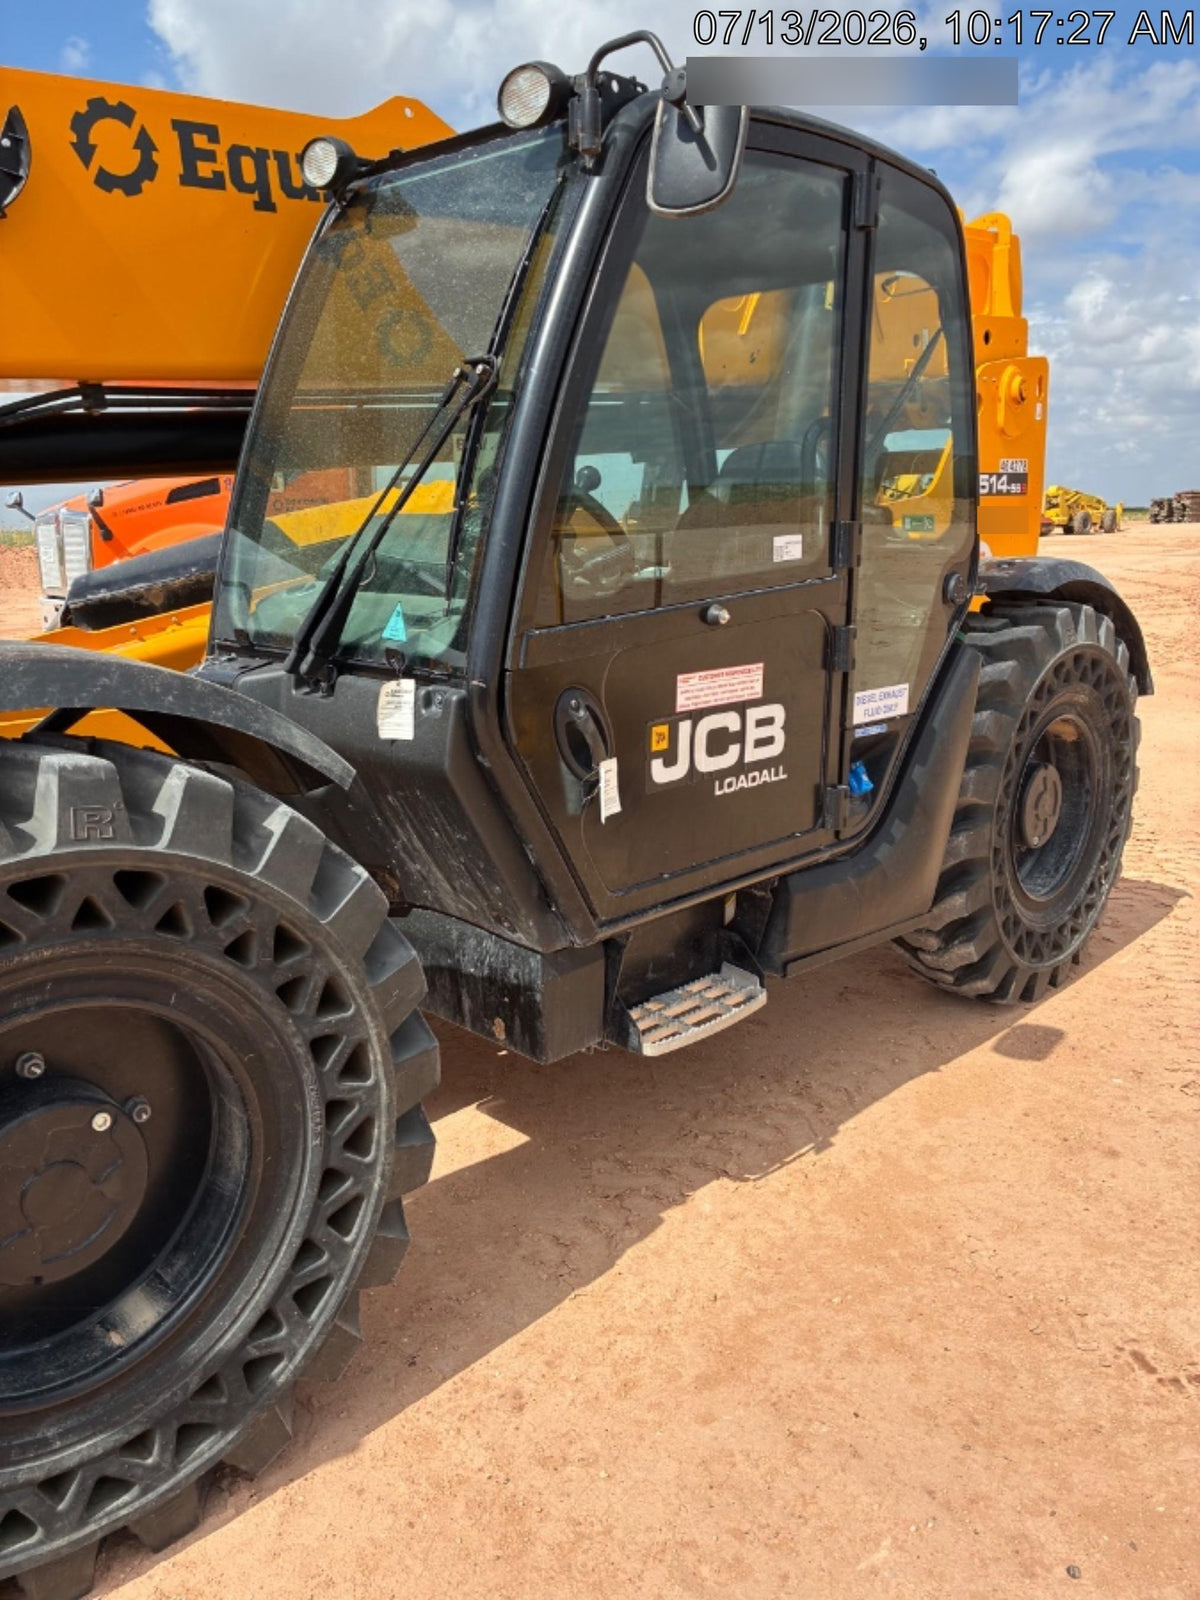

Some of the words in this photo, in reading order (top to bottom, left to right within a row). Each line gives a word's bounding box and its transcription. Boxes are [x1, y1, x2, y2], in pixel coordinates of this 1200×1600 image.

[171, 119, 332, 213] Equ
[651, 703, 786, 784] JCB
[714, 765, 788, 796] LOADALL
